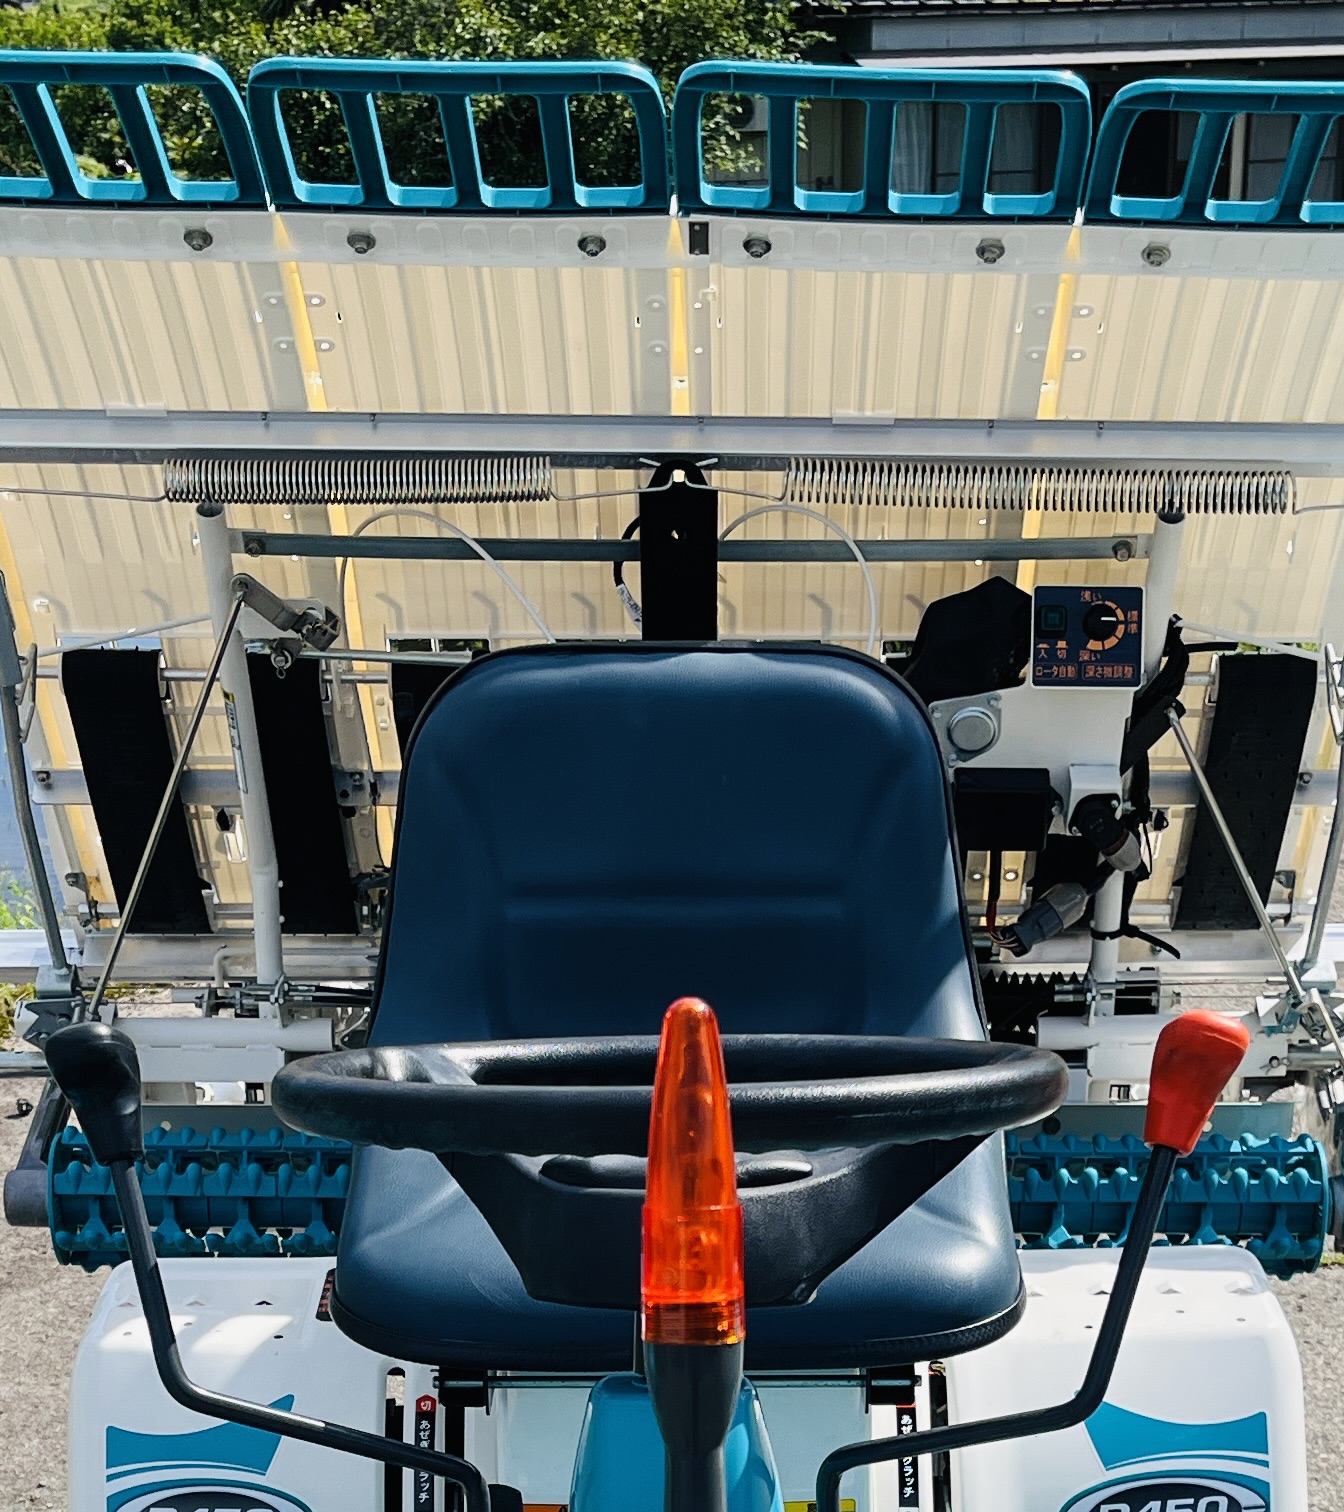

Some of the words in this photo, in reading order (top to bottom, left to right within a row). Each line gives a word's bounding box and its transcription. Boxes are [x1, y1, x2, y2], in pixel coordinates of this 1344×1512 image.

[1035, 665, 1077, 678] ロータ自動
[421, 1401, 432, 1411] 切
[418, 1420, 431, 1503] あぜぎラッチ
[901, 1414, 915, 1498] あぜクラッチ
